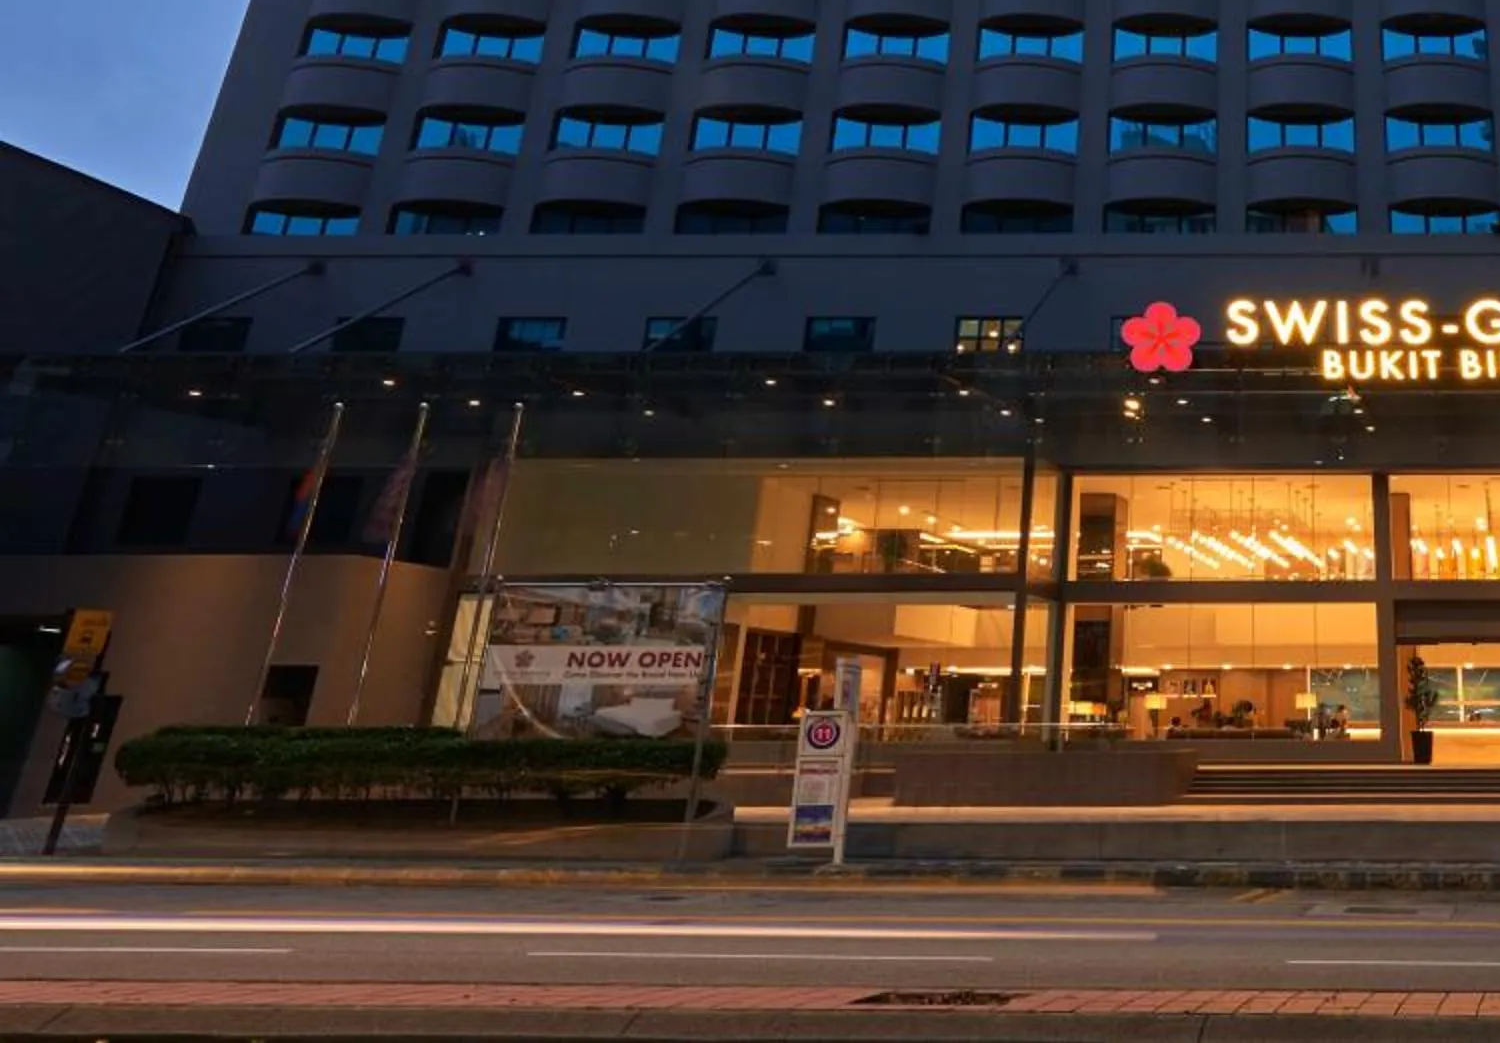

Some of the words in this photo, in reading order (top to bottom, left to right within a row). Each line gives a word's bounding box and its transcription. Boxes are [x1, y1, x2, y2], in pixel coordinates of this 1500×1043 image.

[1321, 348, 1443, 380] BUKIT
[567, 651, 632, 668] NOW
[638, 651, 703, 668] OPEN
